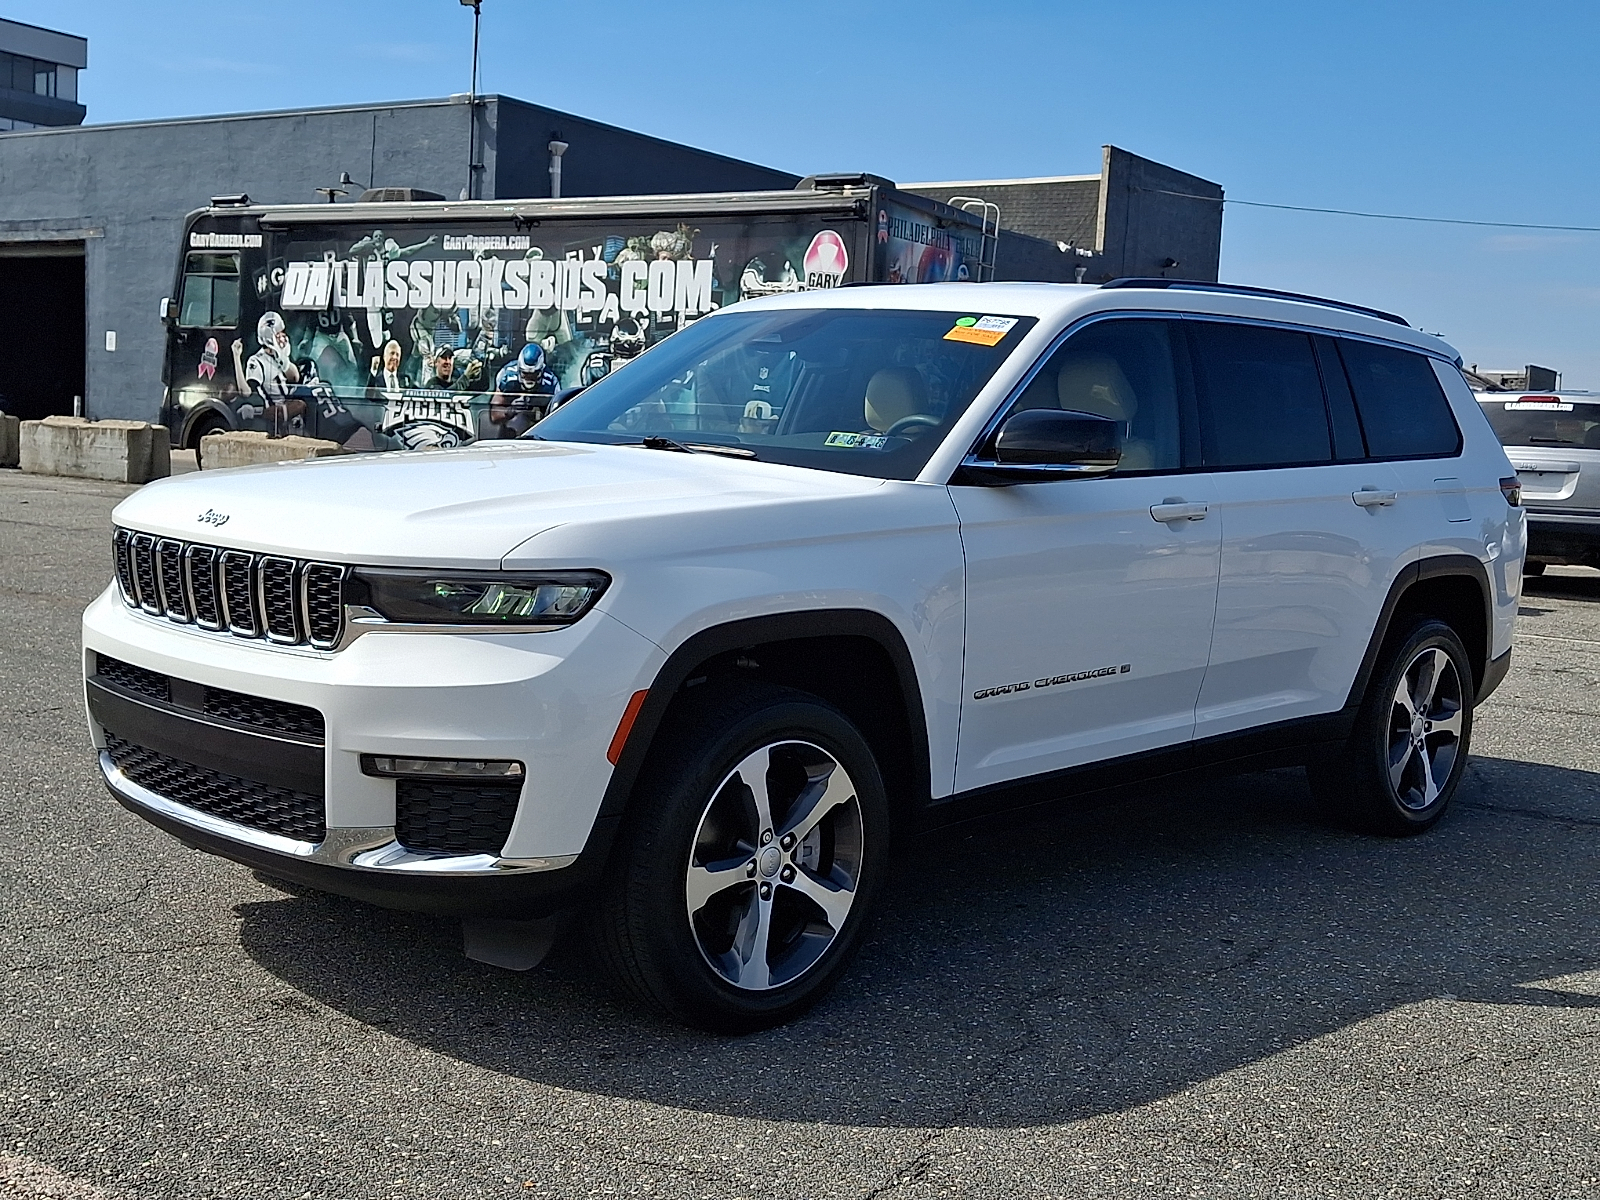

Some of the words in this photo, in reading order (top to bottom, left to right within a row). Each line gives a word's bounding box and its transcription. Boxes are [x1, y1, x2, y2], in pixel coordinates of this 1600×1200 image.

[887, 216, 951, 252] PHILADELPHIA
[808, 272, 839, 289] GARY
[381, 391, 476, 437] EAGLES
[197, 508, 230, 528] Jeep
[973, 681, 1031, 700] GRAND
[1034, 666, 1118, 688] CHEROKEE
